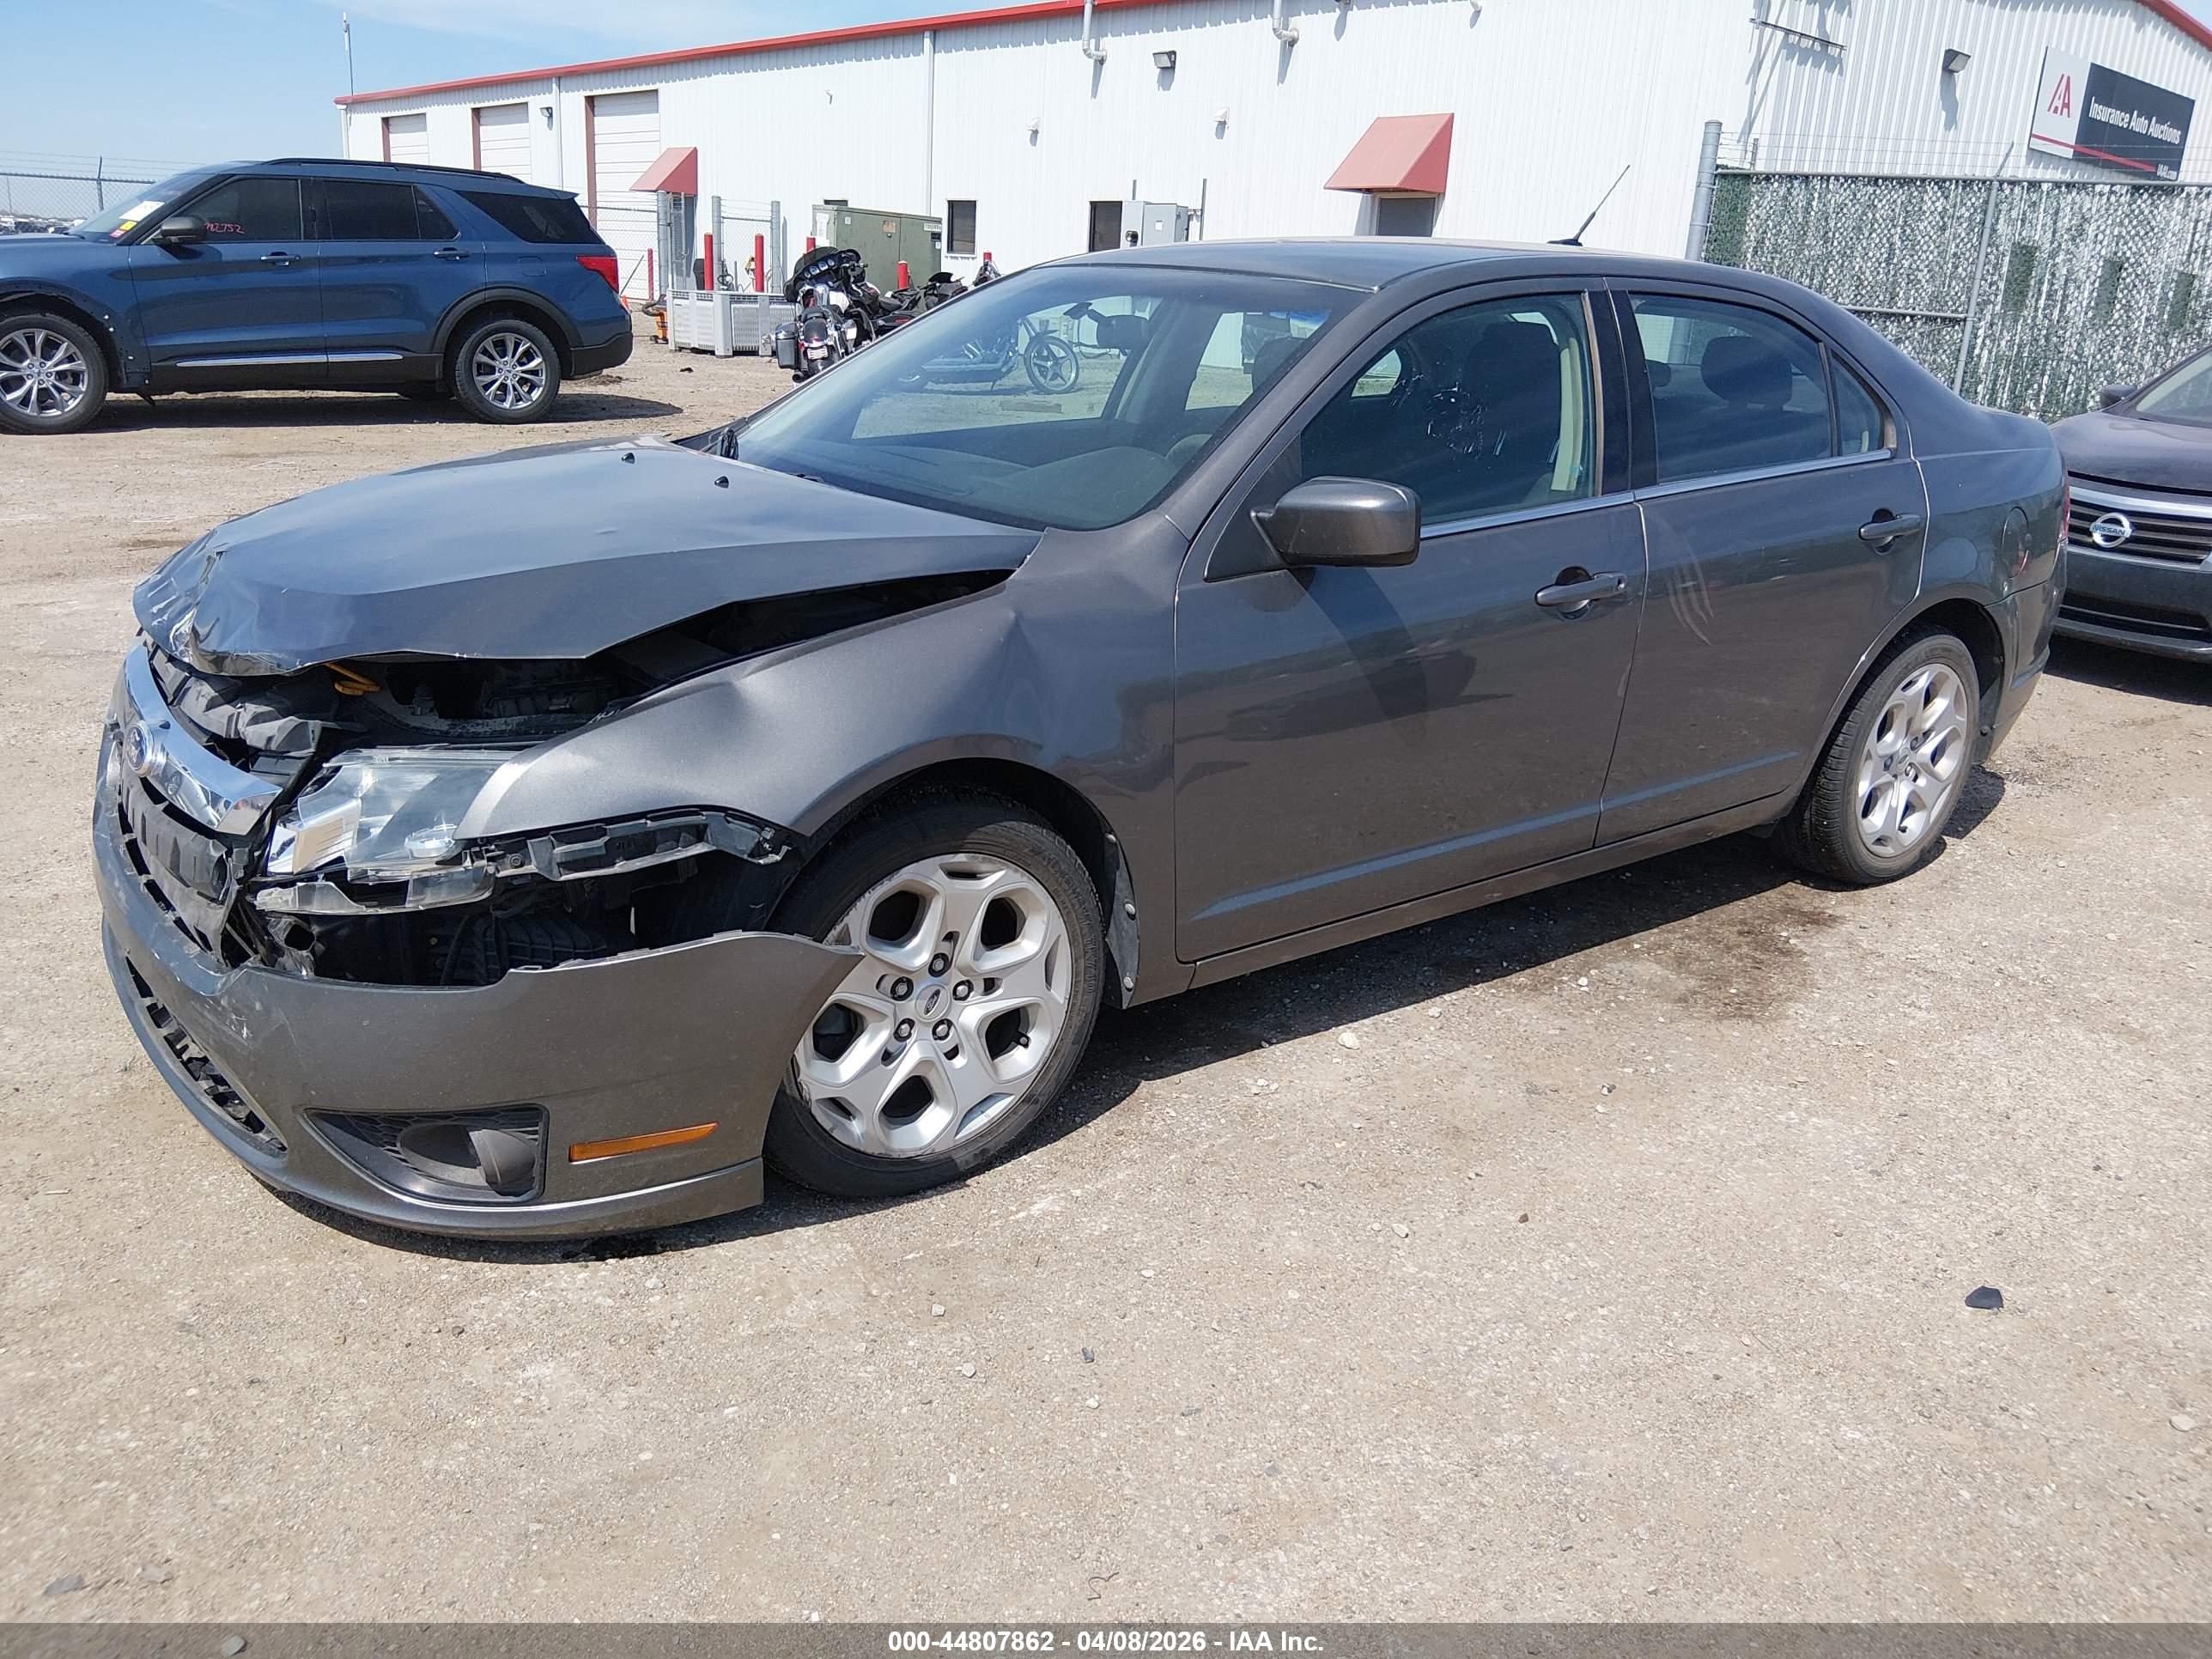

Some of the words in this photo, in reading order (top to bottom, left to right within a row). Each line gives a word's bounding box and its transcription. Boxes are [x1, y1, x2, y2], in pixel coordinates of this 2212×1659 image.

[2088, 96, 2130, 129] Insurance
[2130, 110, 2149, 135] Auto
[2148, 117, 2181, 145] Auctions
[2093, 525, 2126, 536] NISSAN
